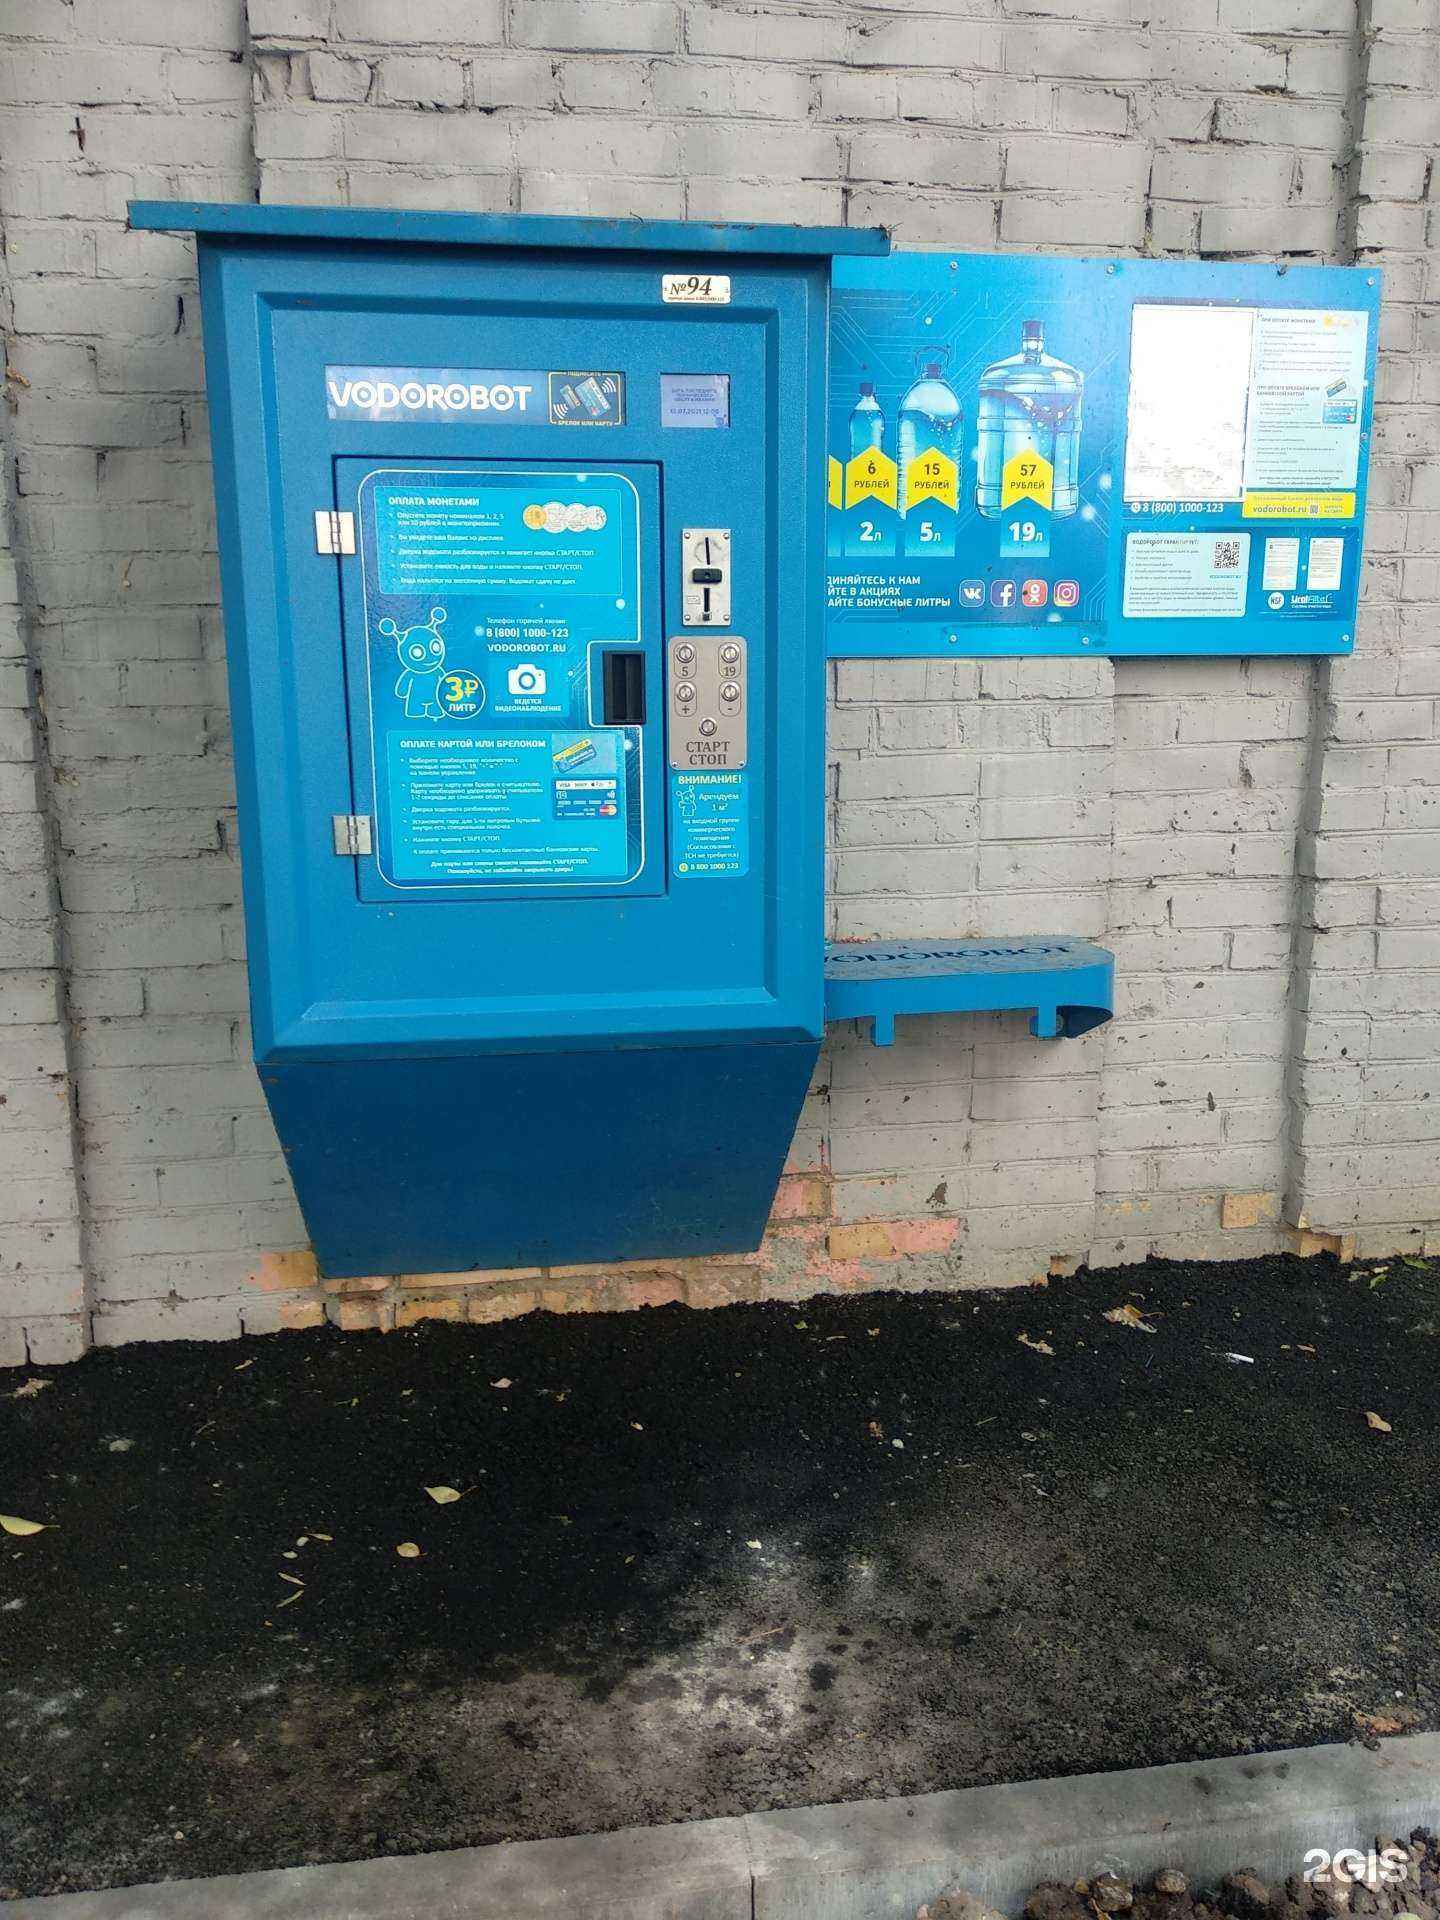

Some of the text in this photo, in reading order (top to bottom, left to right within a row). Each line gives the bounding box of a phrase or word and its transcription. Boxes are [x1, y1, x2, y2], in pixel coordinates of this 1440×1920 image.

[328, 381, 532, 410] VODOROBOT
[868, 463, 876, 475] 6
[924, 463, 940, 475] 15
[1020, 464, 1036, 476] 57
[854, 480, 890, 488] РУБЛЕЙ
[915, 481, 950, 489] РУБЛЕЙ
[1010, 481, 1045, 489] РУБЛЕЙ
[389, 497, 480, 506] ОПЛАТА МОНЕТАМИ
[1151, 503, 1176, 514] (800)
[1179, 503, 1223, 513] 1000-123
[1253, 504, 1307, 513] vodorobot.ru
[889, 576, 896, 584] К
[899, 576, 921, 584] НАМ
[850, 588, 857, 596] В
[860, 588, 901, 597] АКЦИЯХ
[828, 597, 951, 607] АЙТЕ БОНУСНЫЕ ЛИТРЫ
[486, 628, 569, 638] 8 (800) 1000-123
[487, 644, 566, 653] VODOROBOT.RU
[681, 666, 689, 677] 5
[724, 666, 736, 677] 19
[448, 703, 477, 712] ЛИТР
[400, 739, 546, 749] ОПЛАТЕ КАРТОЙ ИЛИ БРЕЛОКОМ
[686, 741, 730, 753] СТАРТ
[689, 754, 728, 766] СТОП
[678, 775, 742, 784] ВНИМАНИЕ!
